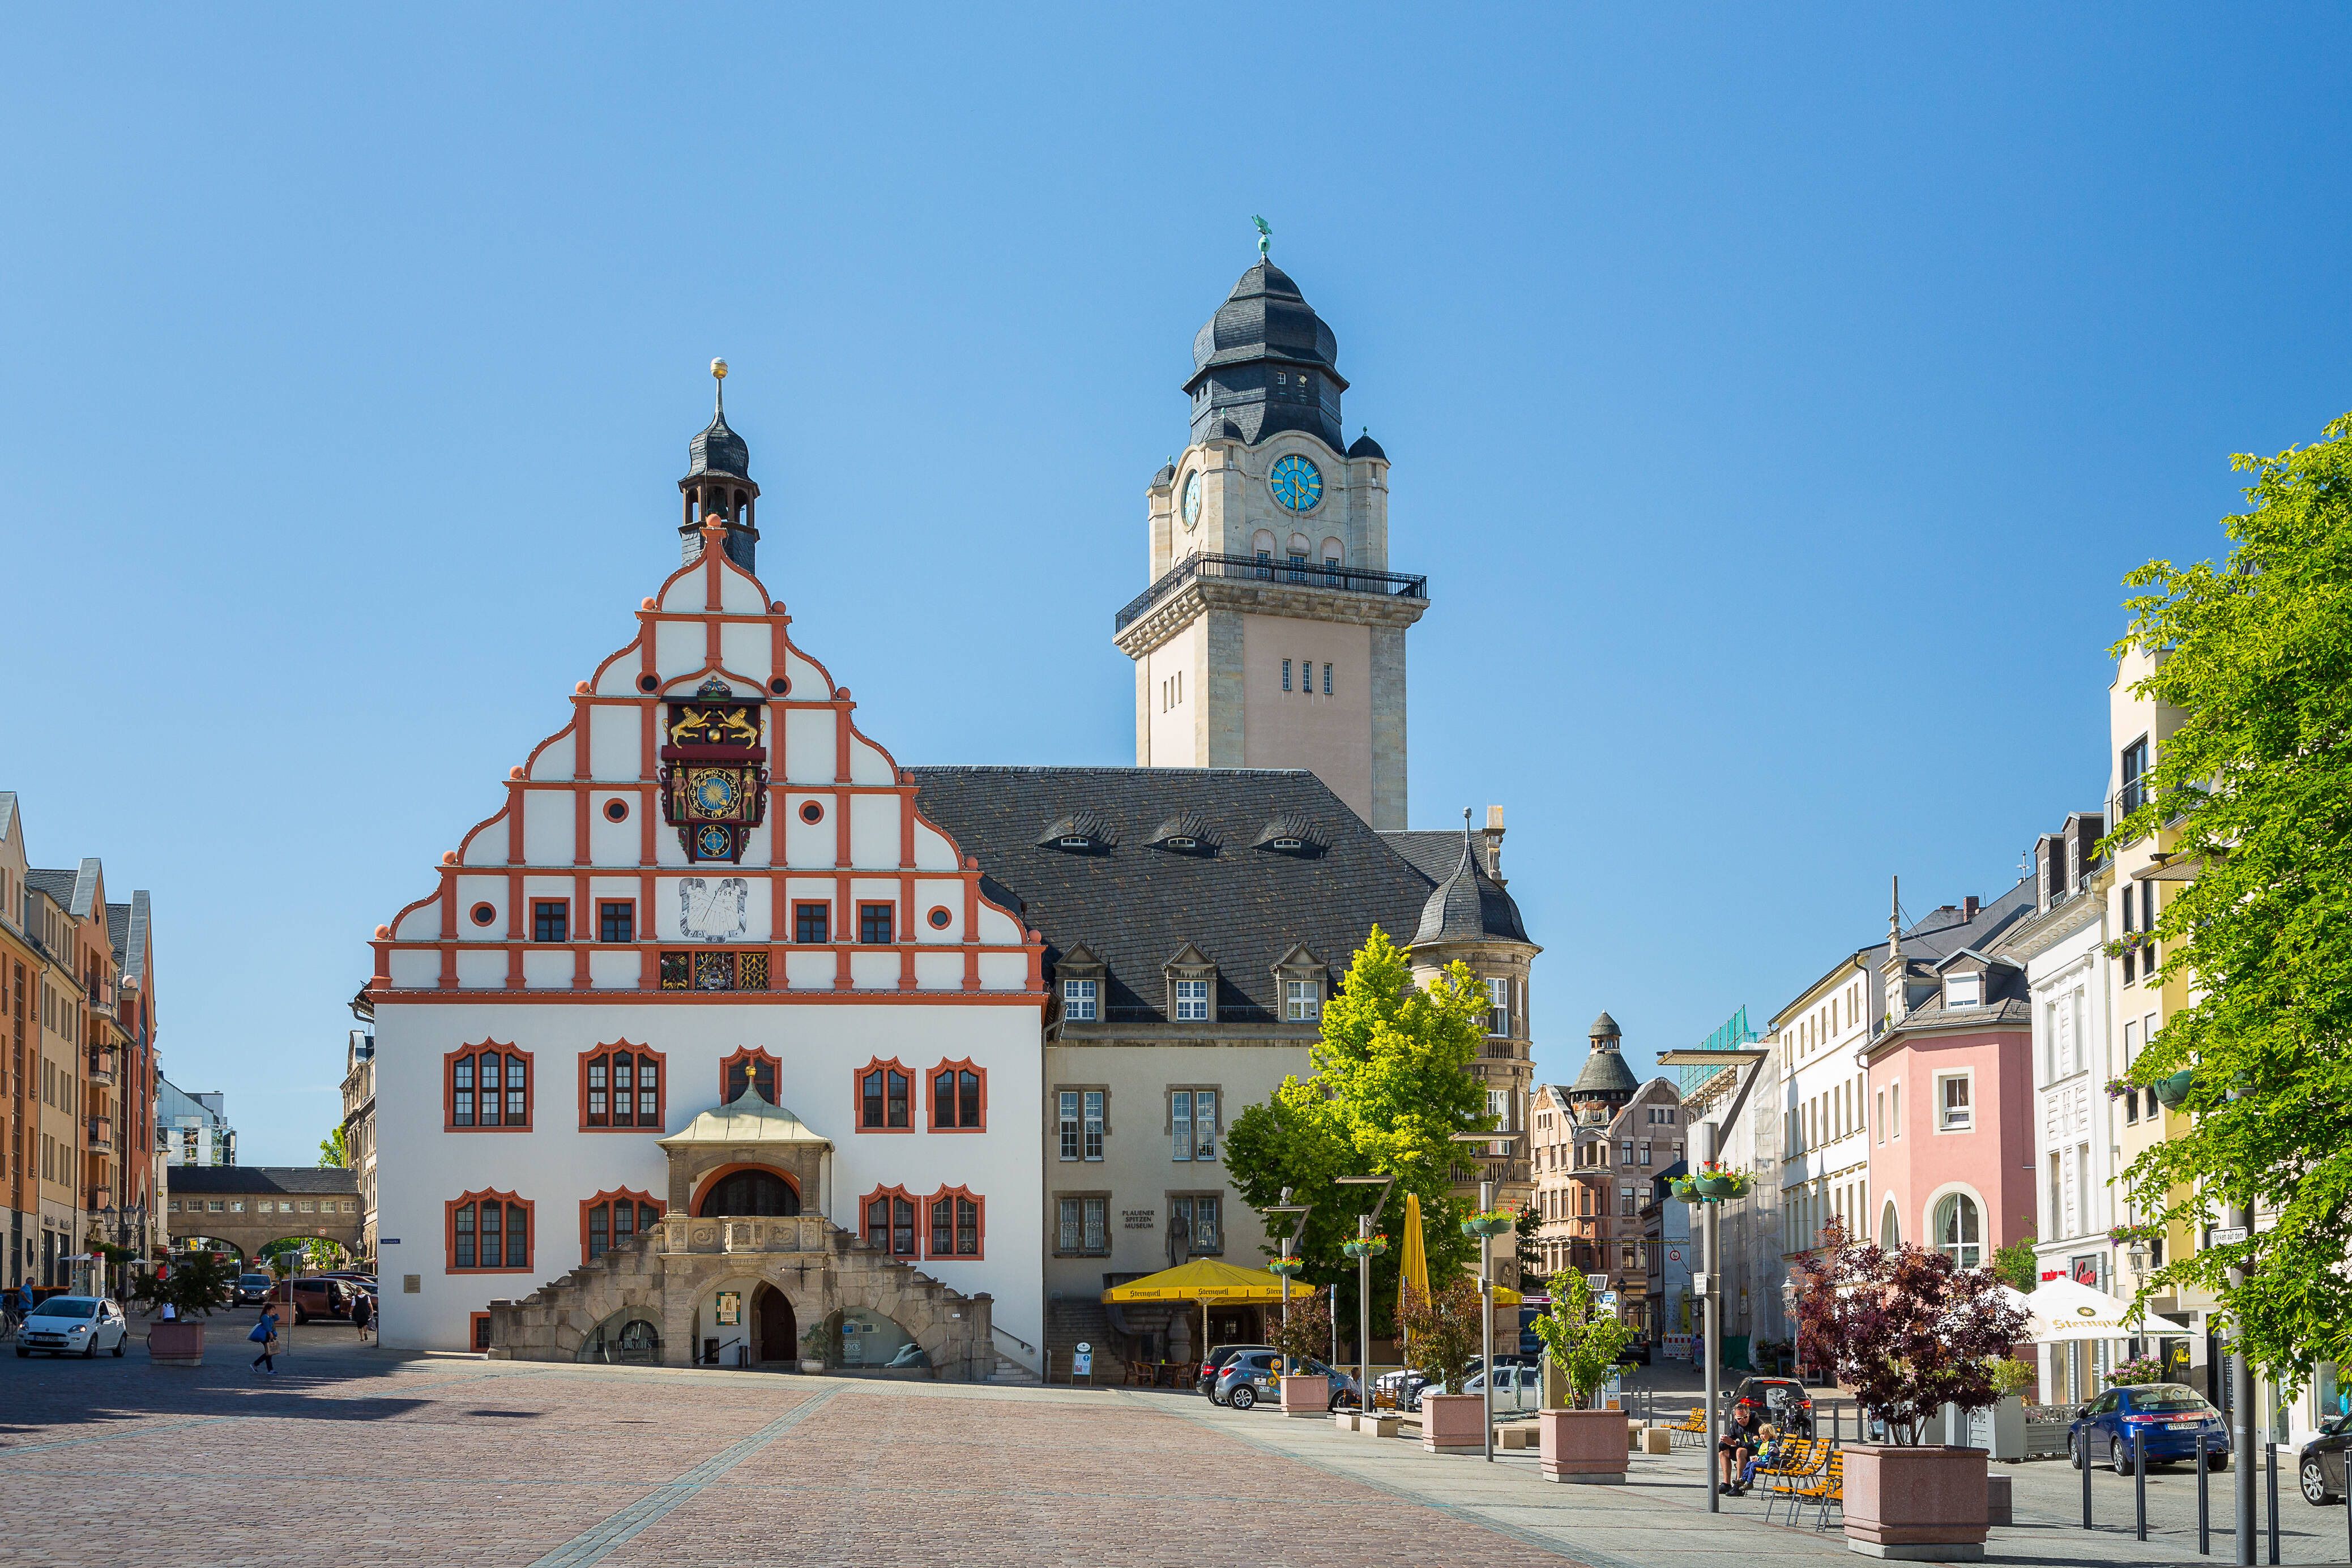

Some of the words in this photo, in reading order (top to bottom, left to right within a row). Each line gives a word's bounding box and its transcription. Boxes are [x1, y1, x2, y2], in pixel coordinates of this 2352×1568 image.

[691, 779, 699, 788] 10
[732, 790, 739, 798] 3
[693, 800, 698, 808] 8
[1130, 1289, 1160, 1298] Sternquell
[1198, 1288, 1228, 1297] Sternquell
[1266, 1287, 1296, 1296] Sternell
